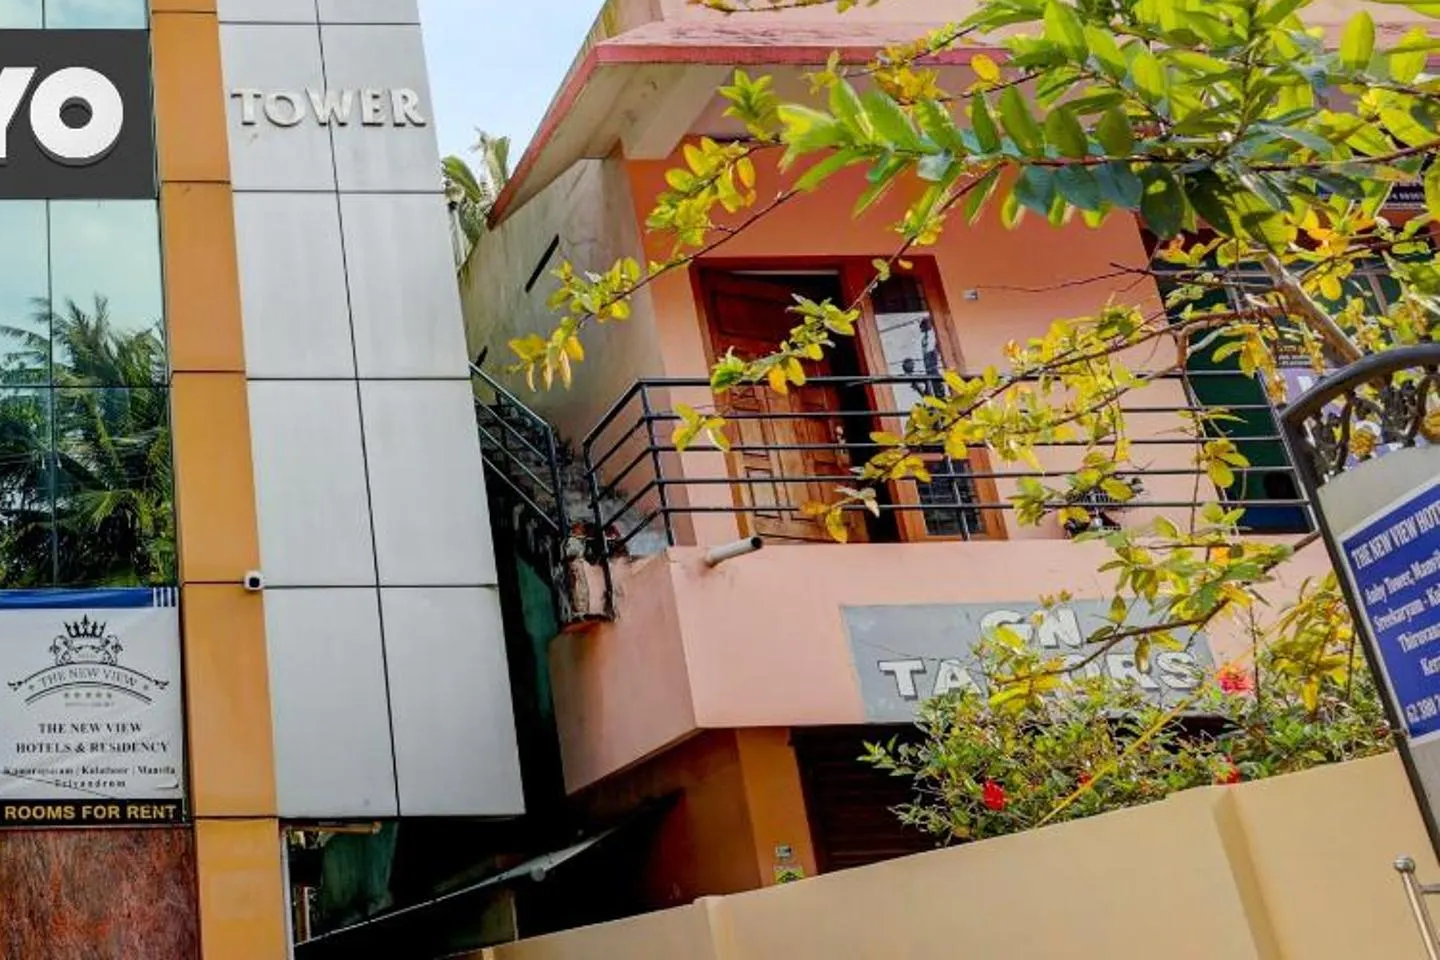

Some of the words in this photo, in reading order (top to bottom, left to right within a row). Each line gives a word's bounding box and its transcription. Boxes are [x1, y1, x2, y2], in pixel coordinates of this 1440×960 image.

[230, 88, 427, 128] TOWER
[39, 670, 67, 688] THE
[68, 668, 99, 681] NEW
[102, 668, 138, 687] VIEW
[39, 723, 66, 734] THE
[70, 723, 101, 733] NEW
[106, 722, 143, 733] VIEW
[16, 742, 71, 754] HOTELS
[74, 742, 86, 753] &
[89, 741, 169, 753] RESIDENCY
[4, 804, 76, 820] ROOMS
[82, 804, 121, 820] FOR
[126, 804, 177, 819] RENT
